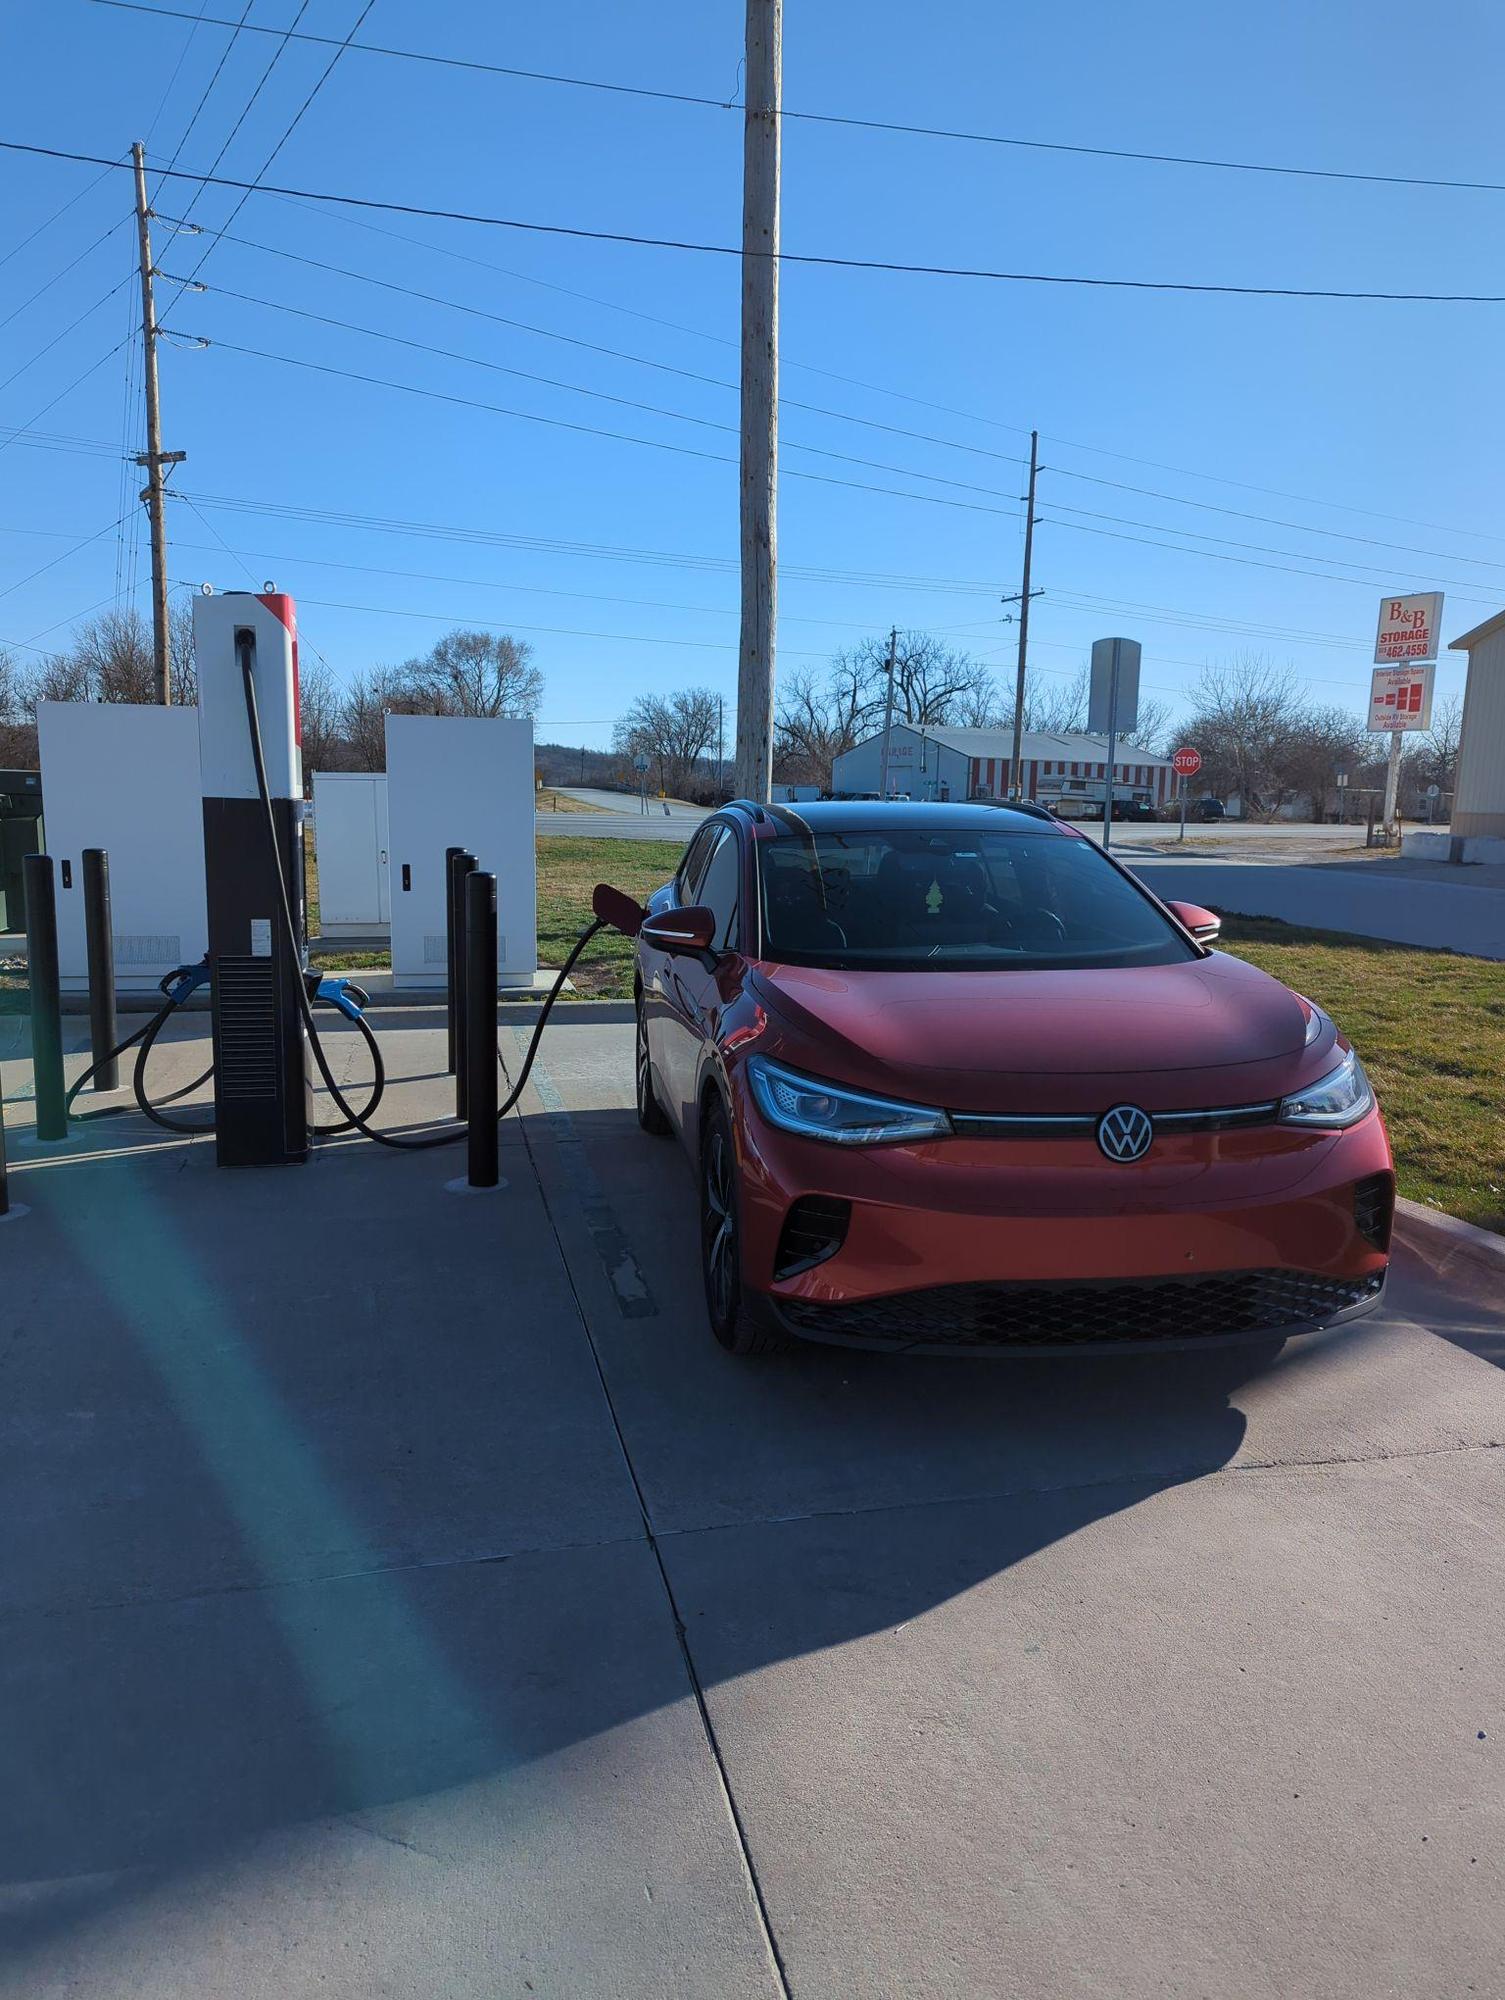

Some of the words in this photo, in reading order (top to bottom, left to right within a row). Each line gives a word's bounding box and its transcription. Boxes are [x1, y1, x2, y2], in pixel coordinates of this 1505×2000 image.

[1390, 601, 1425, 629] B&B
[1380, 629, 1430, 643] STORAGE
[1175, 756, 1199, 767] STOP
[1102, 1109, 1150, 1157] VW
